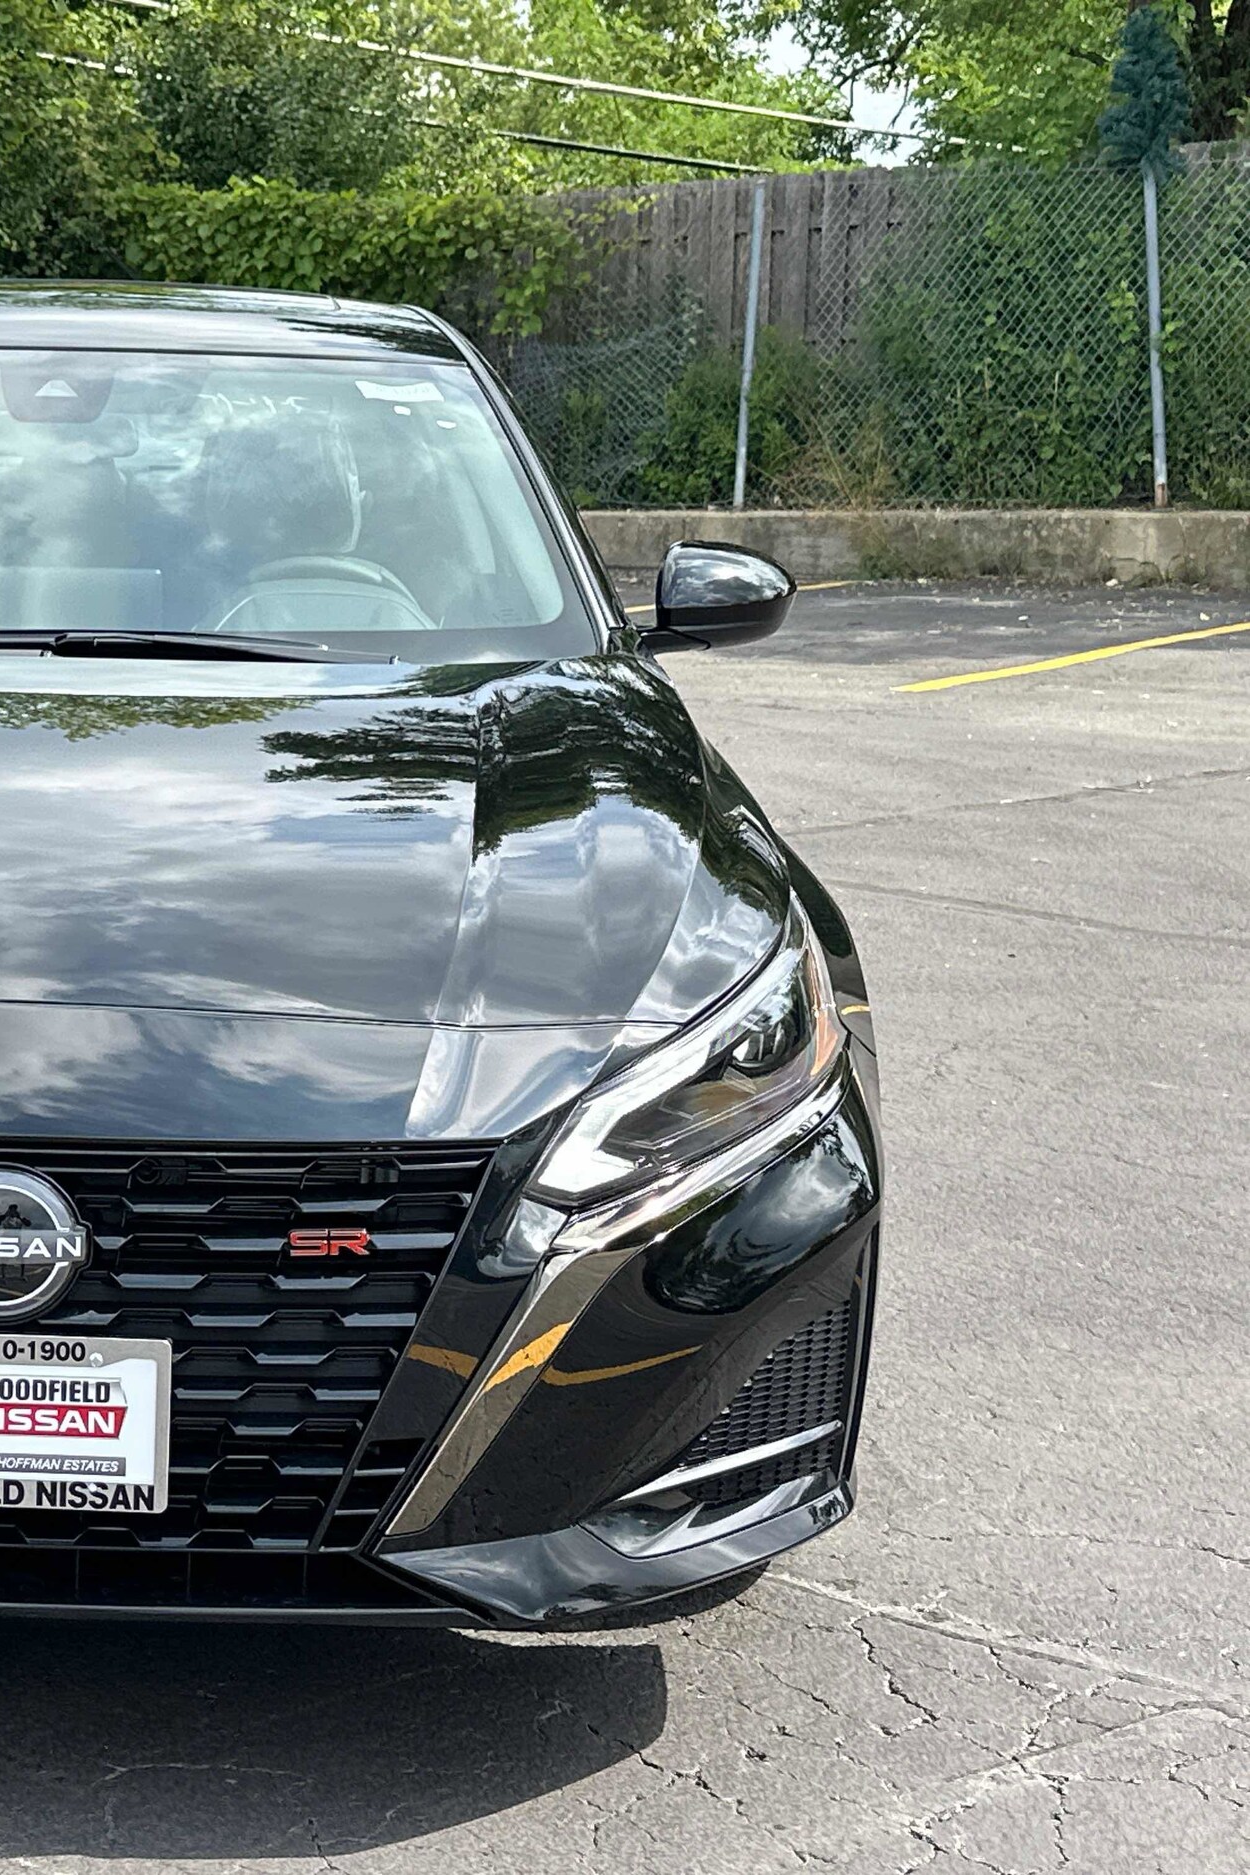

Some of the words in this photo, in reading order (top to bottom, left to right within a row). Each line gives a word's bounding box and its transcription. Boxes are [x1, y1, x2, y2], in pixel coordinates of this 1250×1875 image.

[289, 1227, 370, 1257] SR
[63, 1459, 119, 1472] ESTATES
[36, 1480, 155, 1511] NISSAN
